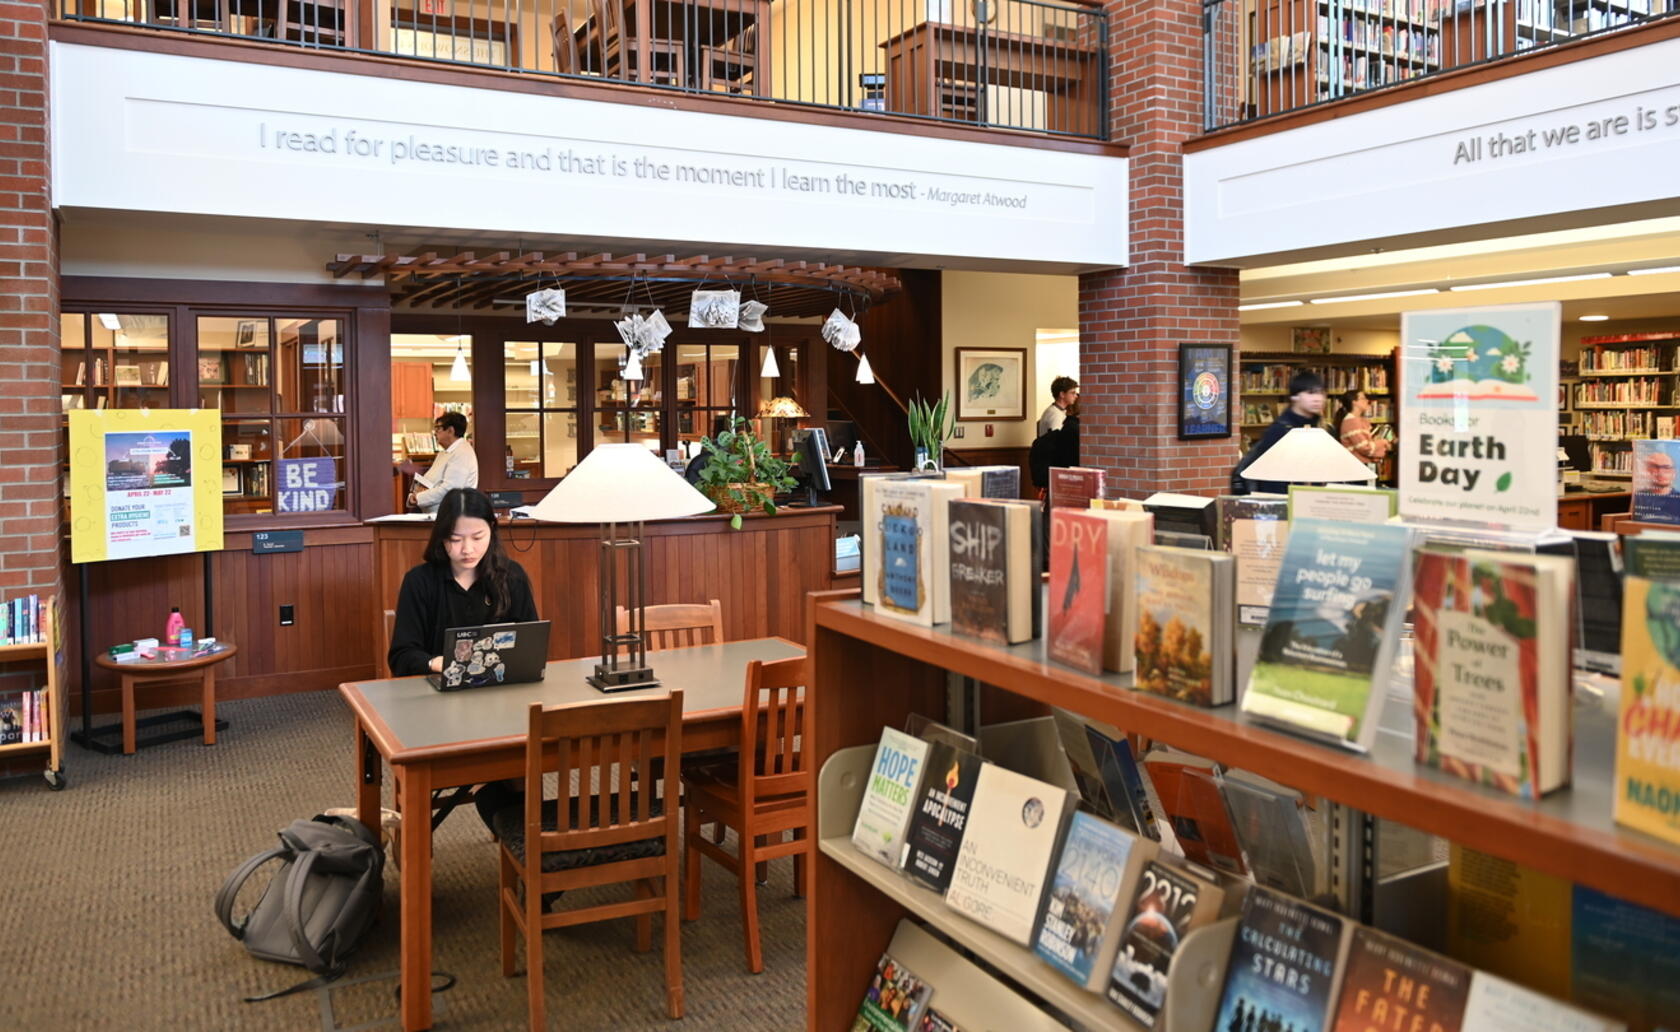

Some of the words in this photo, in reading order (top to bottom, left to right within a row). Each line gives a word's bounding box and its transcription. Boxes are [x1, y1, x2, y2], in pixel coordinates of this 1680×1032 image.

[424, 0, 446, 14] EIT
[1453, 136, 1482, 166] All
[1487, 128, 1537, 159] that
[1542, 124, 1581, 148] we
[1585, 114, 1629, 141] are
[1635, 106, 1658, 132] is
[259, 121, 267, 149] I
[275, 127, 337, 154] read
[344, 129, 384, 158] for
[390, 134, 499, 167] pleasure
[505, 147, 552, 172] and
[557, 149, 606, 176] that
[611, 154, 628, 177] is
[633, 155, 671, 181] the
[675, 163, 765, 189] moment
[770, 166, 777, 189] I
[782, 167, 831, 194] learn
[835, 172, 867, 197] the
[870, 181, 917, 200] most
[927, 186, 981, 207] Margaret
[982, 191, 1028, 209] Atwood
[1419, 433, 1507, 461] Earth
[286, 463, 319, 489] BE
[1418, 460, 1481, 492] Day
[277, 489, 330, 512] KIND
[950, 520, 1003, 561] SHIP
[1053, 517, 1104, 556] DRY
[1316, 548, 1337, 567] let
[1338, 556, 1362, 575] my
[1295, 567, 1350, 588] people
[1349, 577, 1373, 594] go
[1446, 628, 1510, 659] Power
[1451, 663, 1506, 692] Trees
[876, 746, 919, 788] HOPE
[872, 774, 910, 807] MATTERS
[963, 838, 978, 856] AN
[957, 866, 990, 894] TRUTH
[958, 853, 1036, 898] INCONVENIENT
[962, 894, 993, 921] GORE
[1241, 926, 1332, 978] CALCULATING
[1251, 952, 1312, 996] STARS
[1383, 967, 1431, 1011] THE
